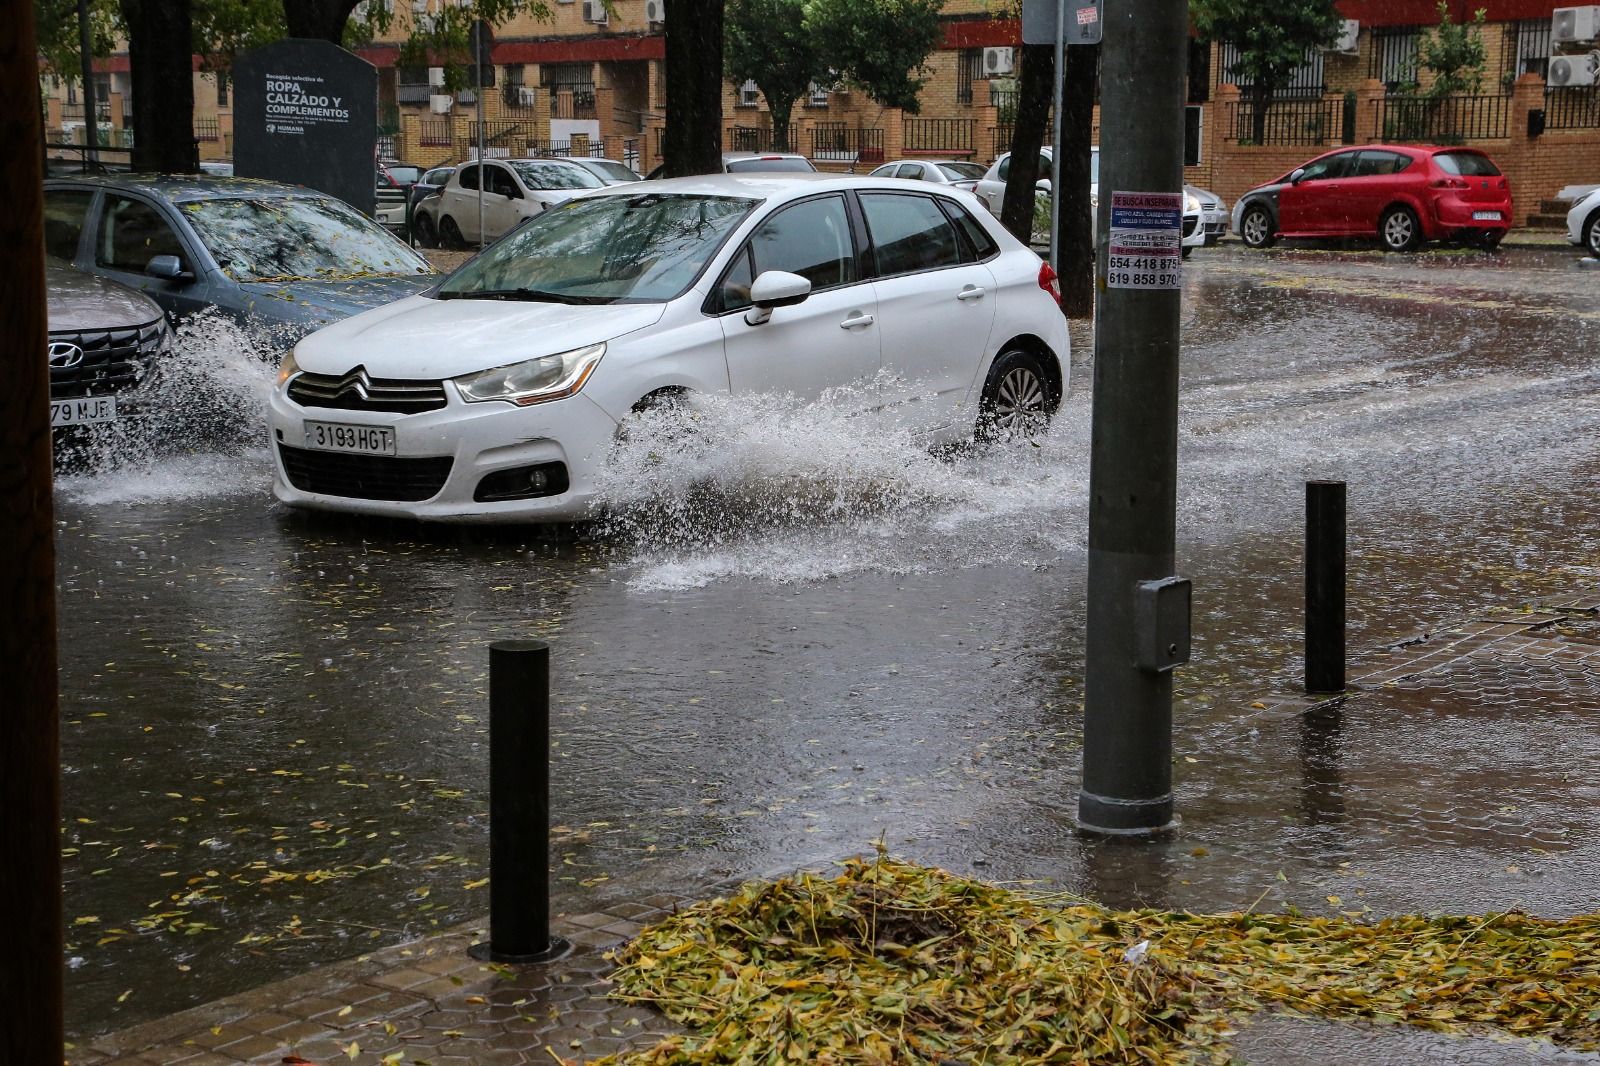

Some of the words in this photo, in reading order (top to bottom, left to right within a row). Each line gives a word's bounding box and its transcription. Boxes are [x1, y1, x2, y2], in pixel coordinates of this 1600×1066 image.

[266, 80, 305, 94] ROPA,
[266, 92, 329, 106] CALZADO
[332, 97, 342, 107] Y
[266, 104, 349, 118] COMPLEMENTOS
[1114, 197, 1122, 205] SE
[1123, 197, 1143, 206] BUSCA
[1110, 257, 1129, 268] 654
[1134, 258, 1156, 269] 418
[1160, 259, 1177, 269] 875
[1110, 273, 1129, 284] 619
[1133, 274, 1155, 284] 858
[1159, 274, 1176, 285] 970
